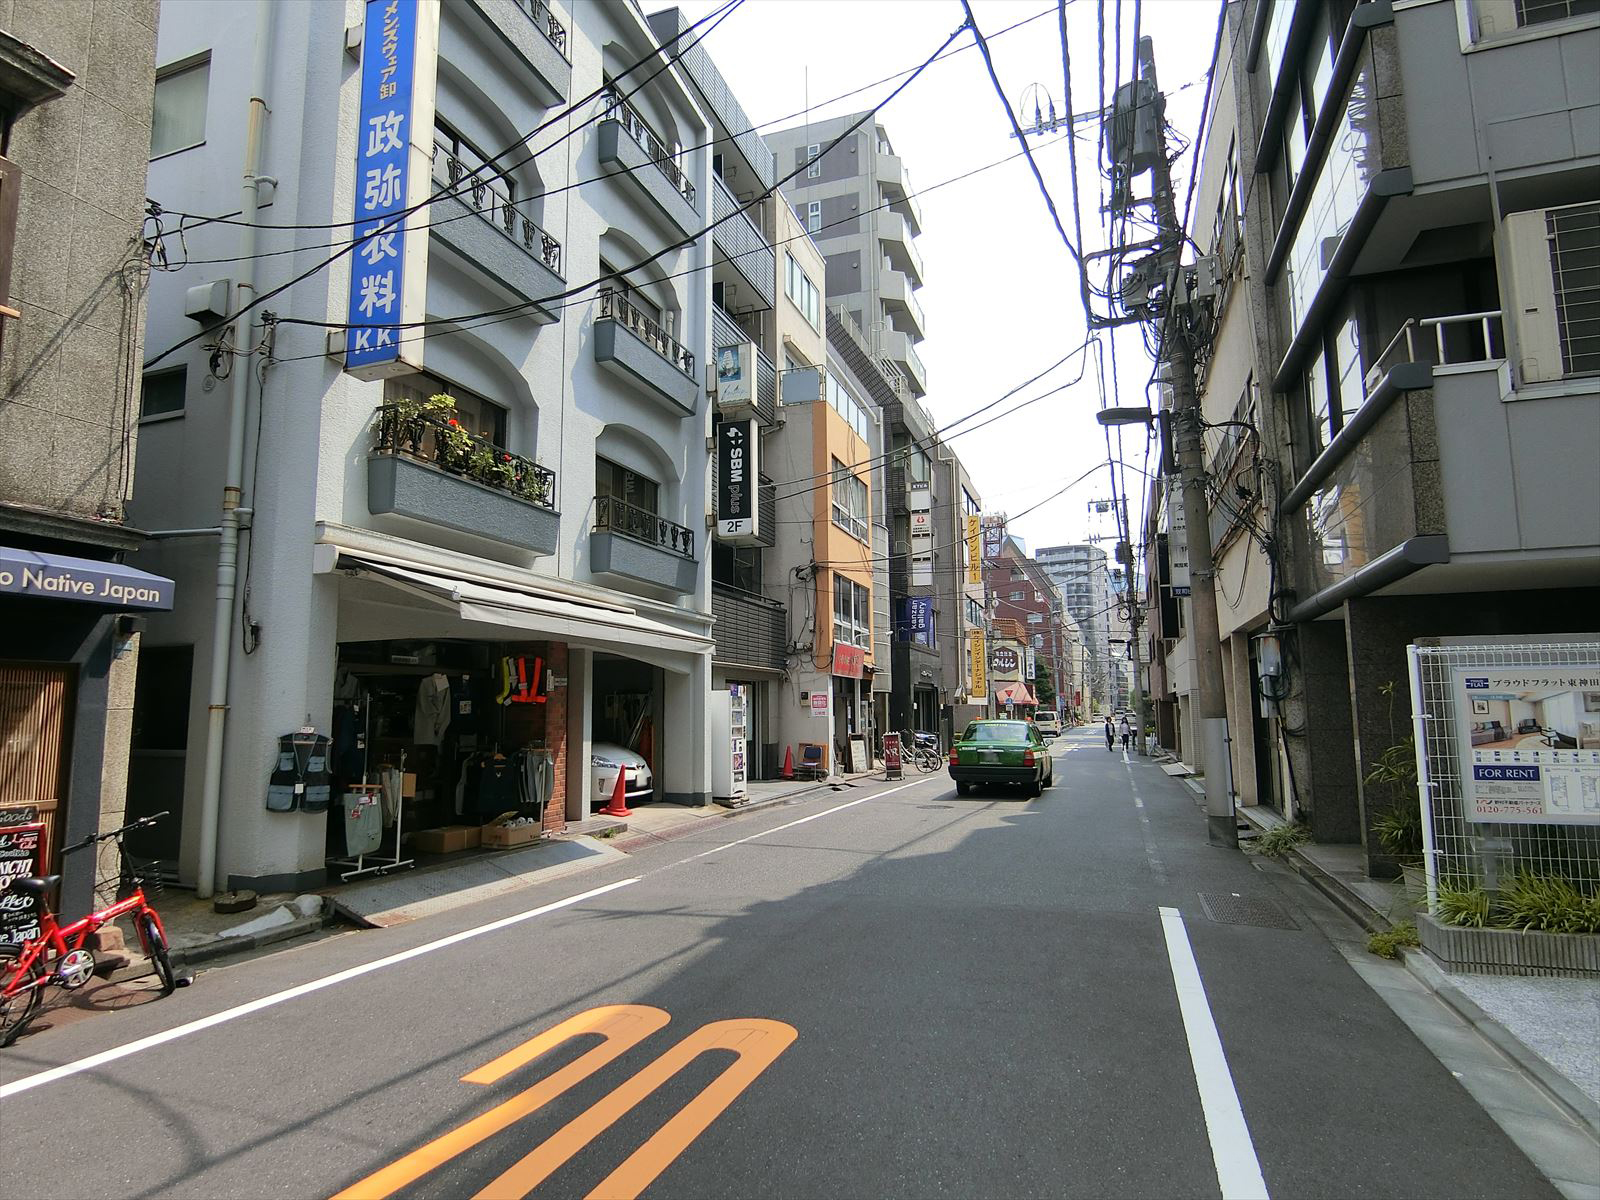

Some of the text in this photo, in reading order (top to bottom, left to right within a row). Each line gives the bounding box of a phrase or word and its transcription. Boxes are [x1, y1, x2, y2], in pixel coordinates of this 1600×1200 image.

[728, 447, 743, 514] SBM plus
[727, 520, 743, 533] 2F
[0, 567, 160, 604] o Native Japan
[910, 599, 918, 629] kanzan
[918, 601, 927, 629] gallery
[1479, 768, 1535, 778] FOR RENT
[1476, 806, 1543, 814] 0120-775-561
